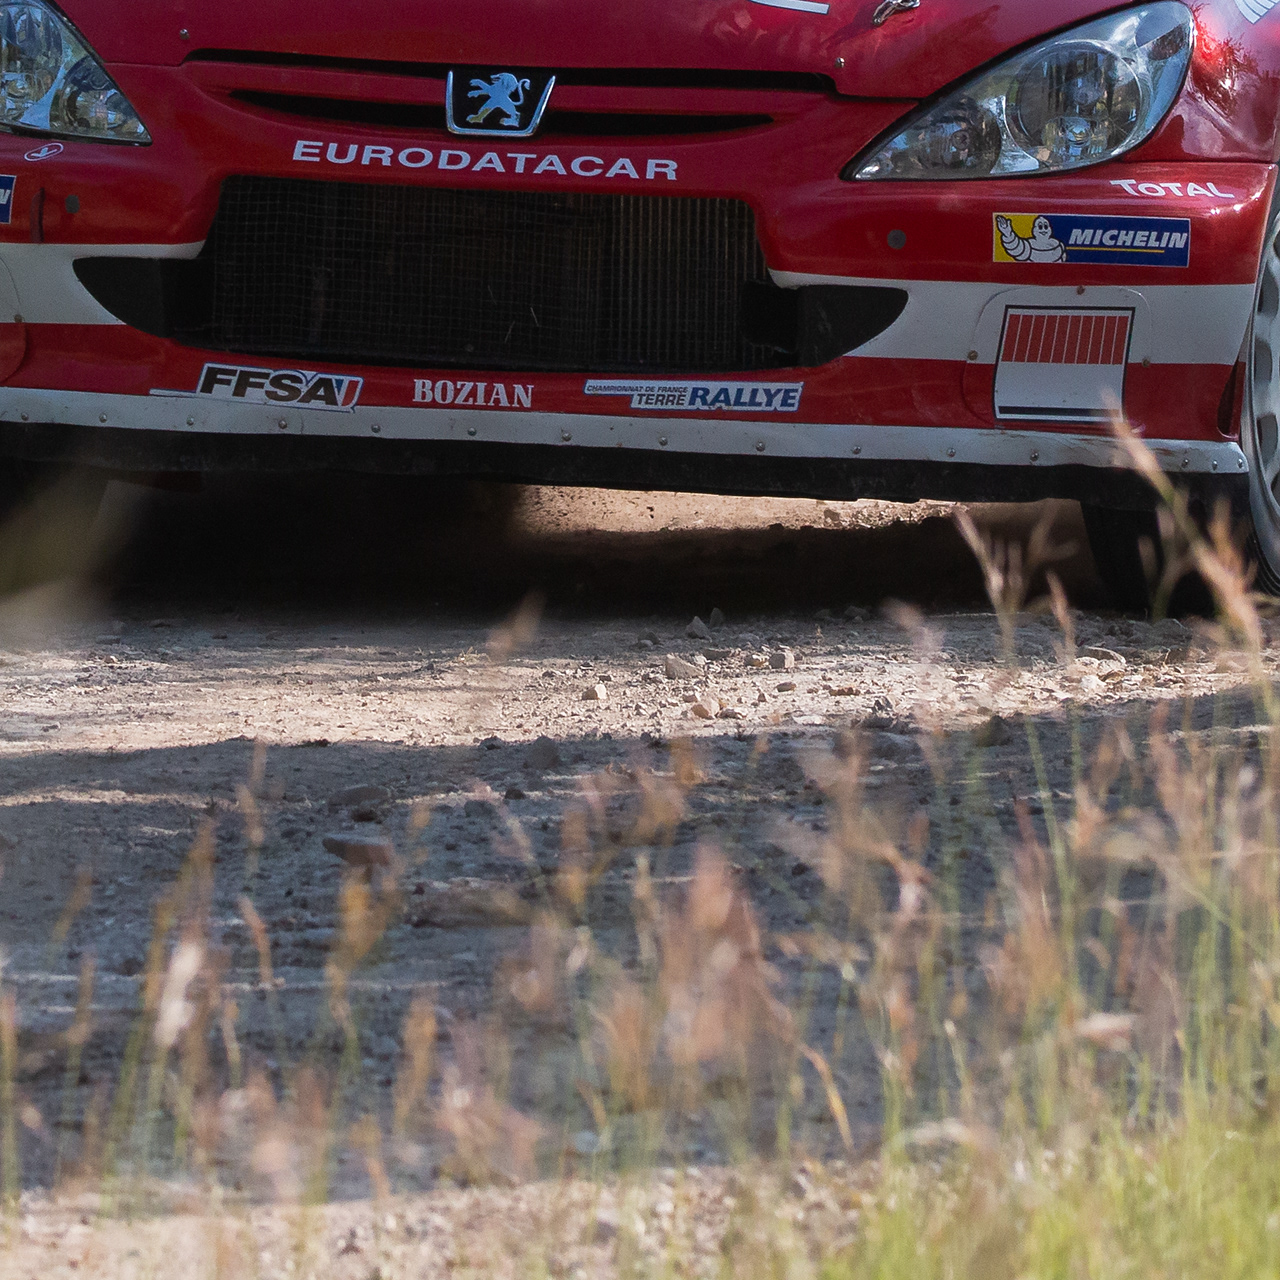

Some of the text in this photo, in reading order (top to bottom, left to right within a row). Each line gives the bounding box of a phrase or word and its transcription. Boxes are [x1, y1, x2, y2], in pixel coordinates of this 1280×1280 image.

[292, 140, 679, 181] EURODATACAR
[1109, 179, 1235, 199] TOTAL
[1068, 229, 1188, 249] MICHELIN
[199, 366, 342, 407] FFSA
[412, 378, 535, 408] BOZIAN
[586, 384, 644, 393] CHAMPIONNAT
[657, 386, 689, 394] FRANCE
[636, 386, 799, 408] TERRE RALLYE
